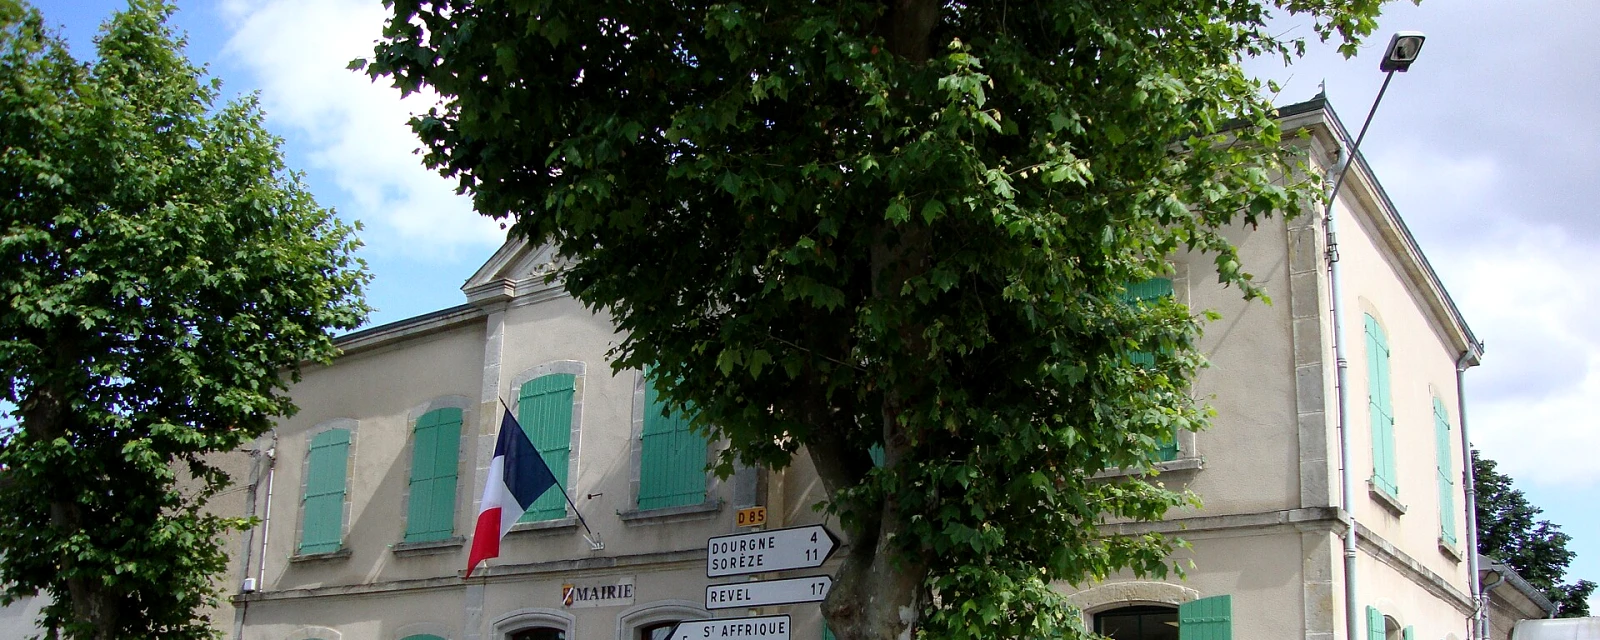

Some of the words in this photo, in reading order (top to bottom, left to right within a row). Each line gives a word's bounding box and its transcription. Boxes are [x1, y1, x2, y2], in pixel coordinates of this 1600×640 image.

[738, 512, 745, 524] D
[749, 510, 764, 522] 85
[712, 536, 775, 554] DOURGNE
[810, 531, 818, 543] 4
[712, 553, 763, 570] SORÈZE
[805, 548, 818, 561] 11
[575, 584, 633, 602] MAIRIE
[710, 589, 751, 602] REVEL
[811, 582, 825, 596] 17
[721, 621, 785, 637] AFFRIQUE
